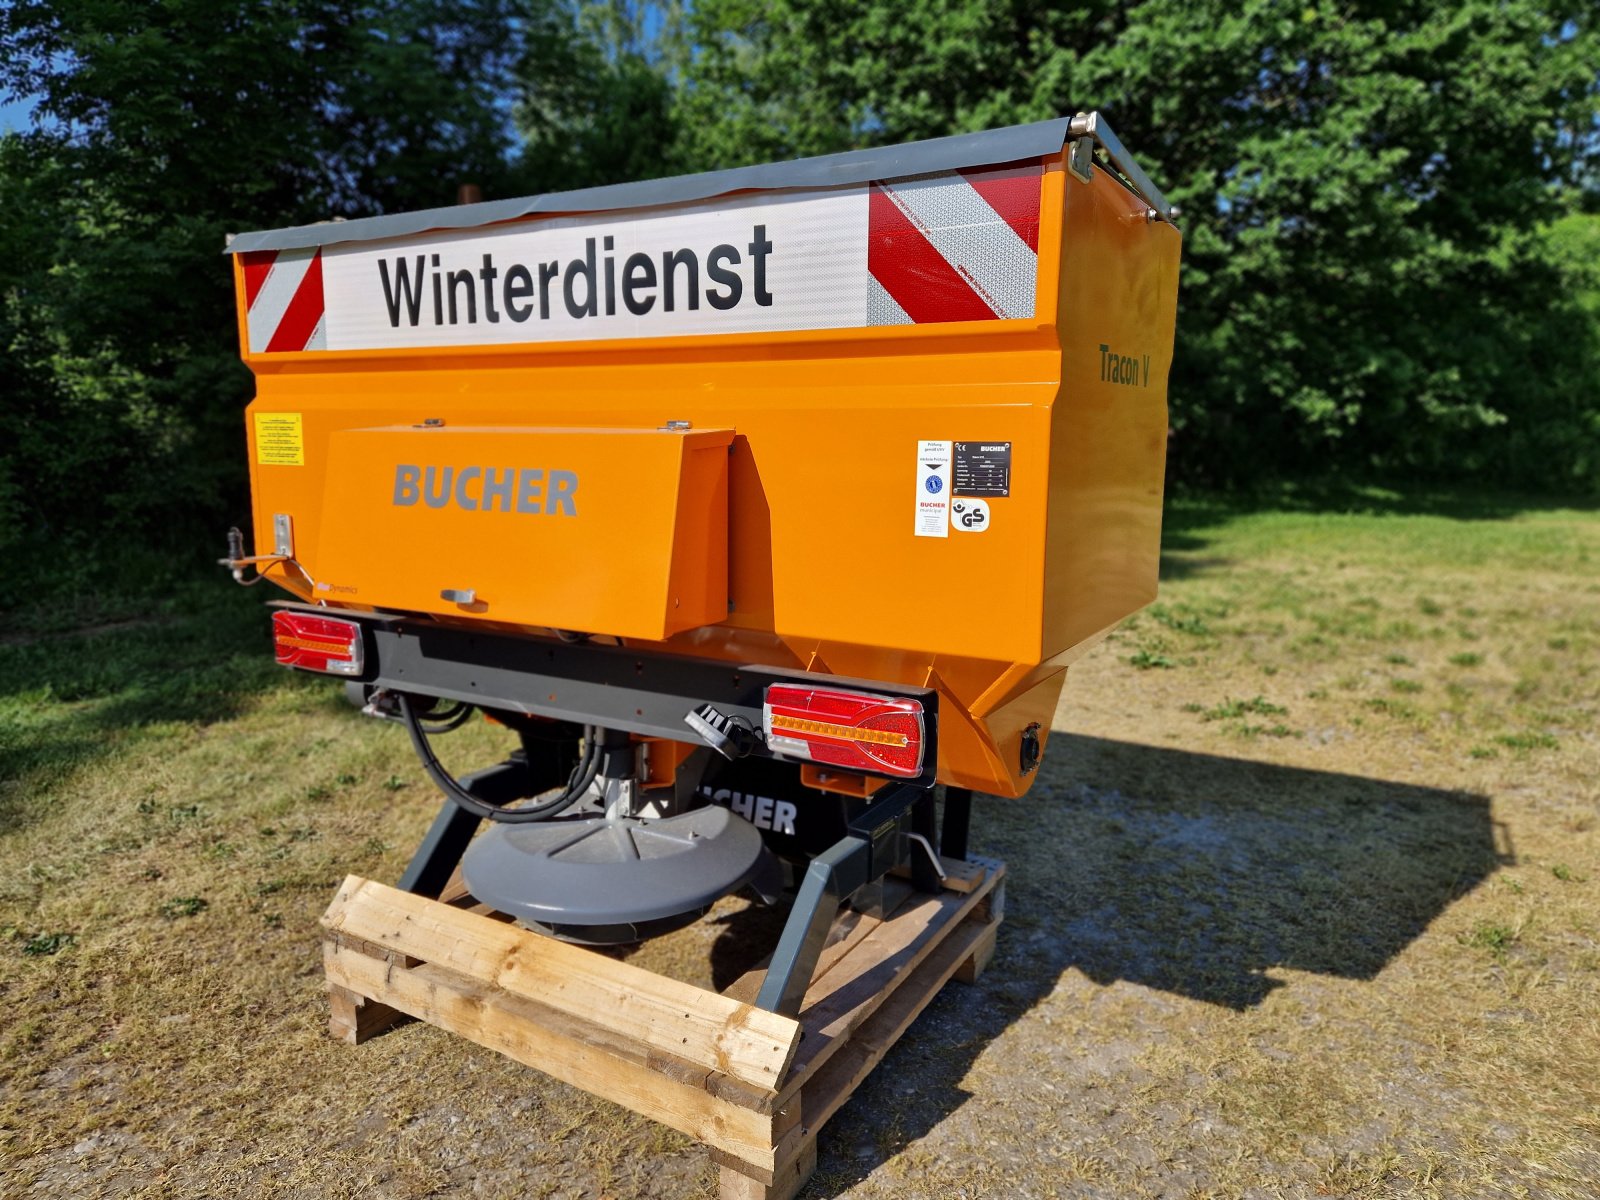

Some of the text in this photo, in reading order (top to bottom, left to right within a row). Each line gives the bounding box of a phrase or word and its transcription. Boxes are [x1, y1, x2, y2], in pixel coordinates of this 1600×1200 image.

[377, 224, 773, 328] Winterdienst
[1099, 344, 1150, 388] Tracon V
[392, 464, 579, 517] BUCHER
[962, 508, 985, 527] GS
